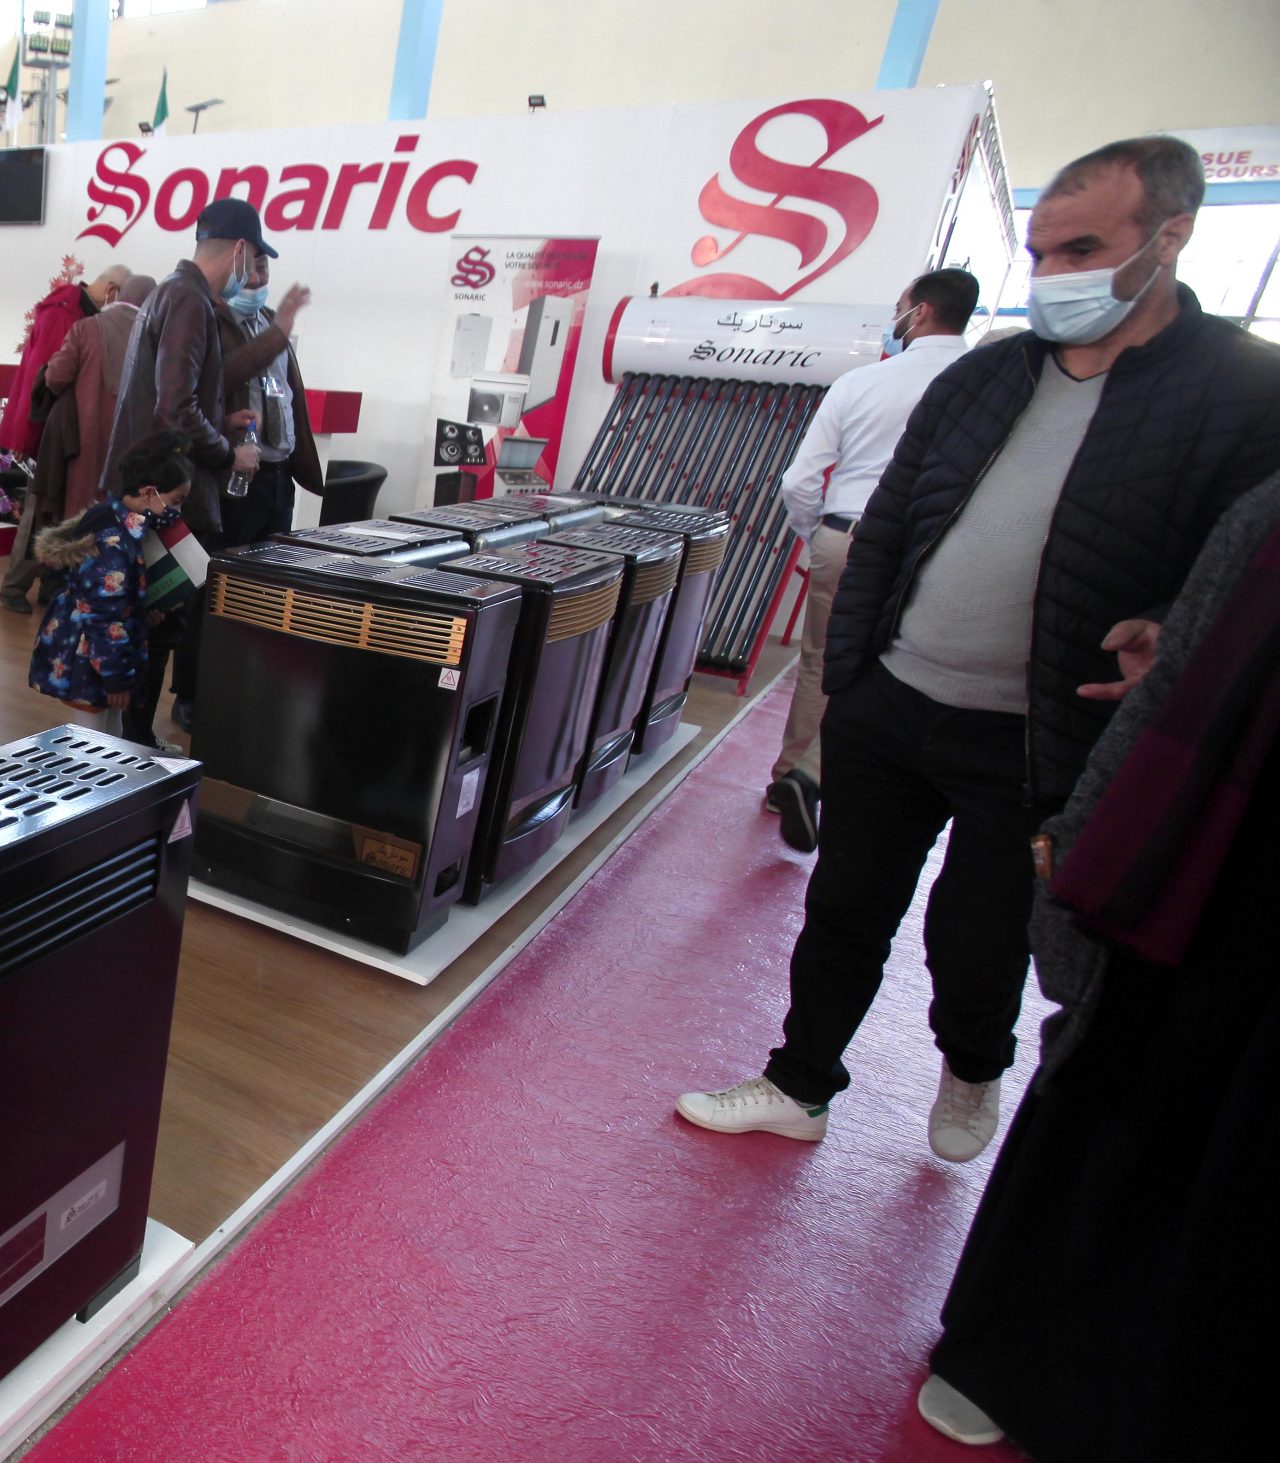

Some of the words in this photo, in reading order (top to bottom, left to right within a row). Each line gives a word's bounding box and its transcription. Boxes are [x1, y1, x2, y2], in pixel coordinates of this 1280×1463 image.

[76, 135, 478, 248] Sonaric
[505, 262, 526, 270] VOTRE
[525, 279, 584, 289] www.sonaric.dz
[454, 292, 487, 301] SONARIC
[716, 312, 804, 336] سوناريك
[689, 340, 822, 368] Sonaric
